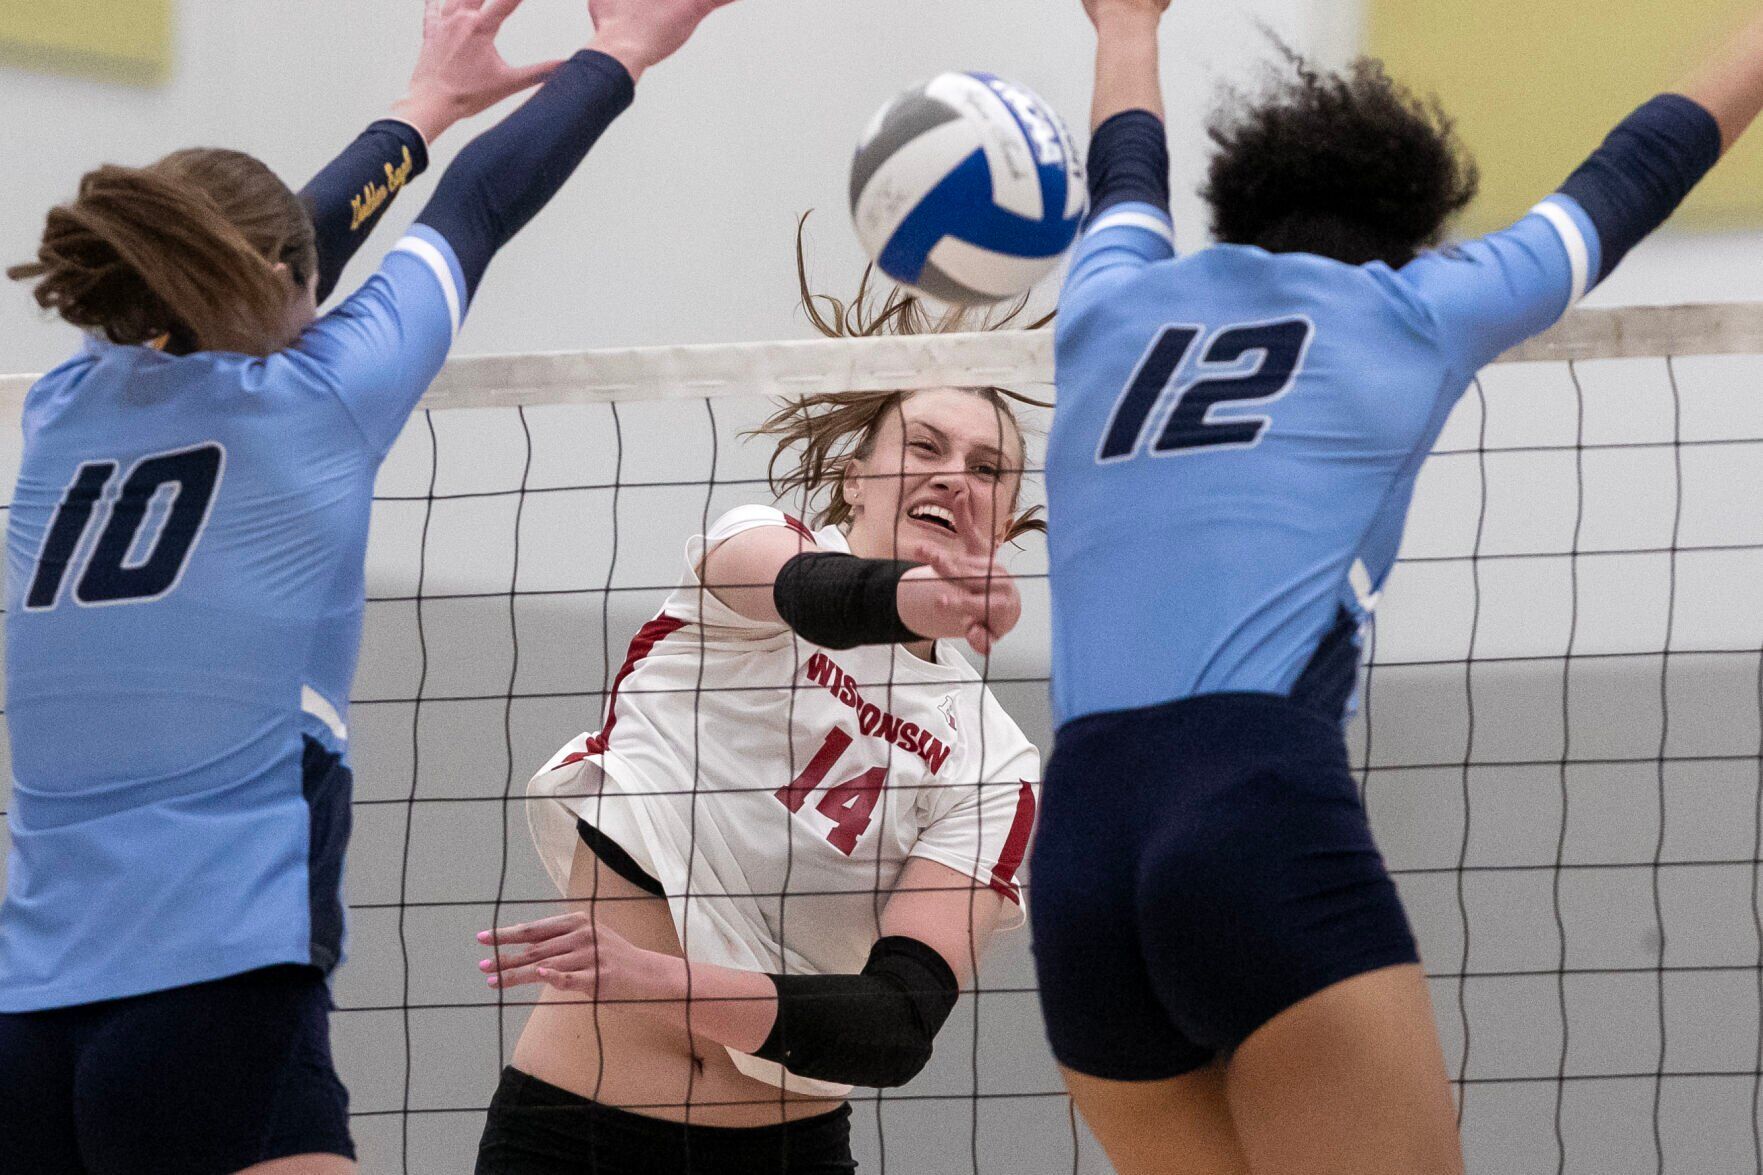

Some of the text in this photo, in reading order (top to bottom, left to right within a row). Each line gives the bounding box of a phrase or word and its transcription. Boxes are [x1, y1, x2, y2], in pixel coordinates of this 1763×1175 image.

[1096, 314, 1315, 464] 12
[24, 441, 226, 611] 10
[806, 652, 951, 776] WISONSIN
[774, 725, 889, 857] 14
